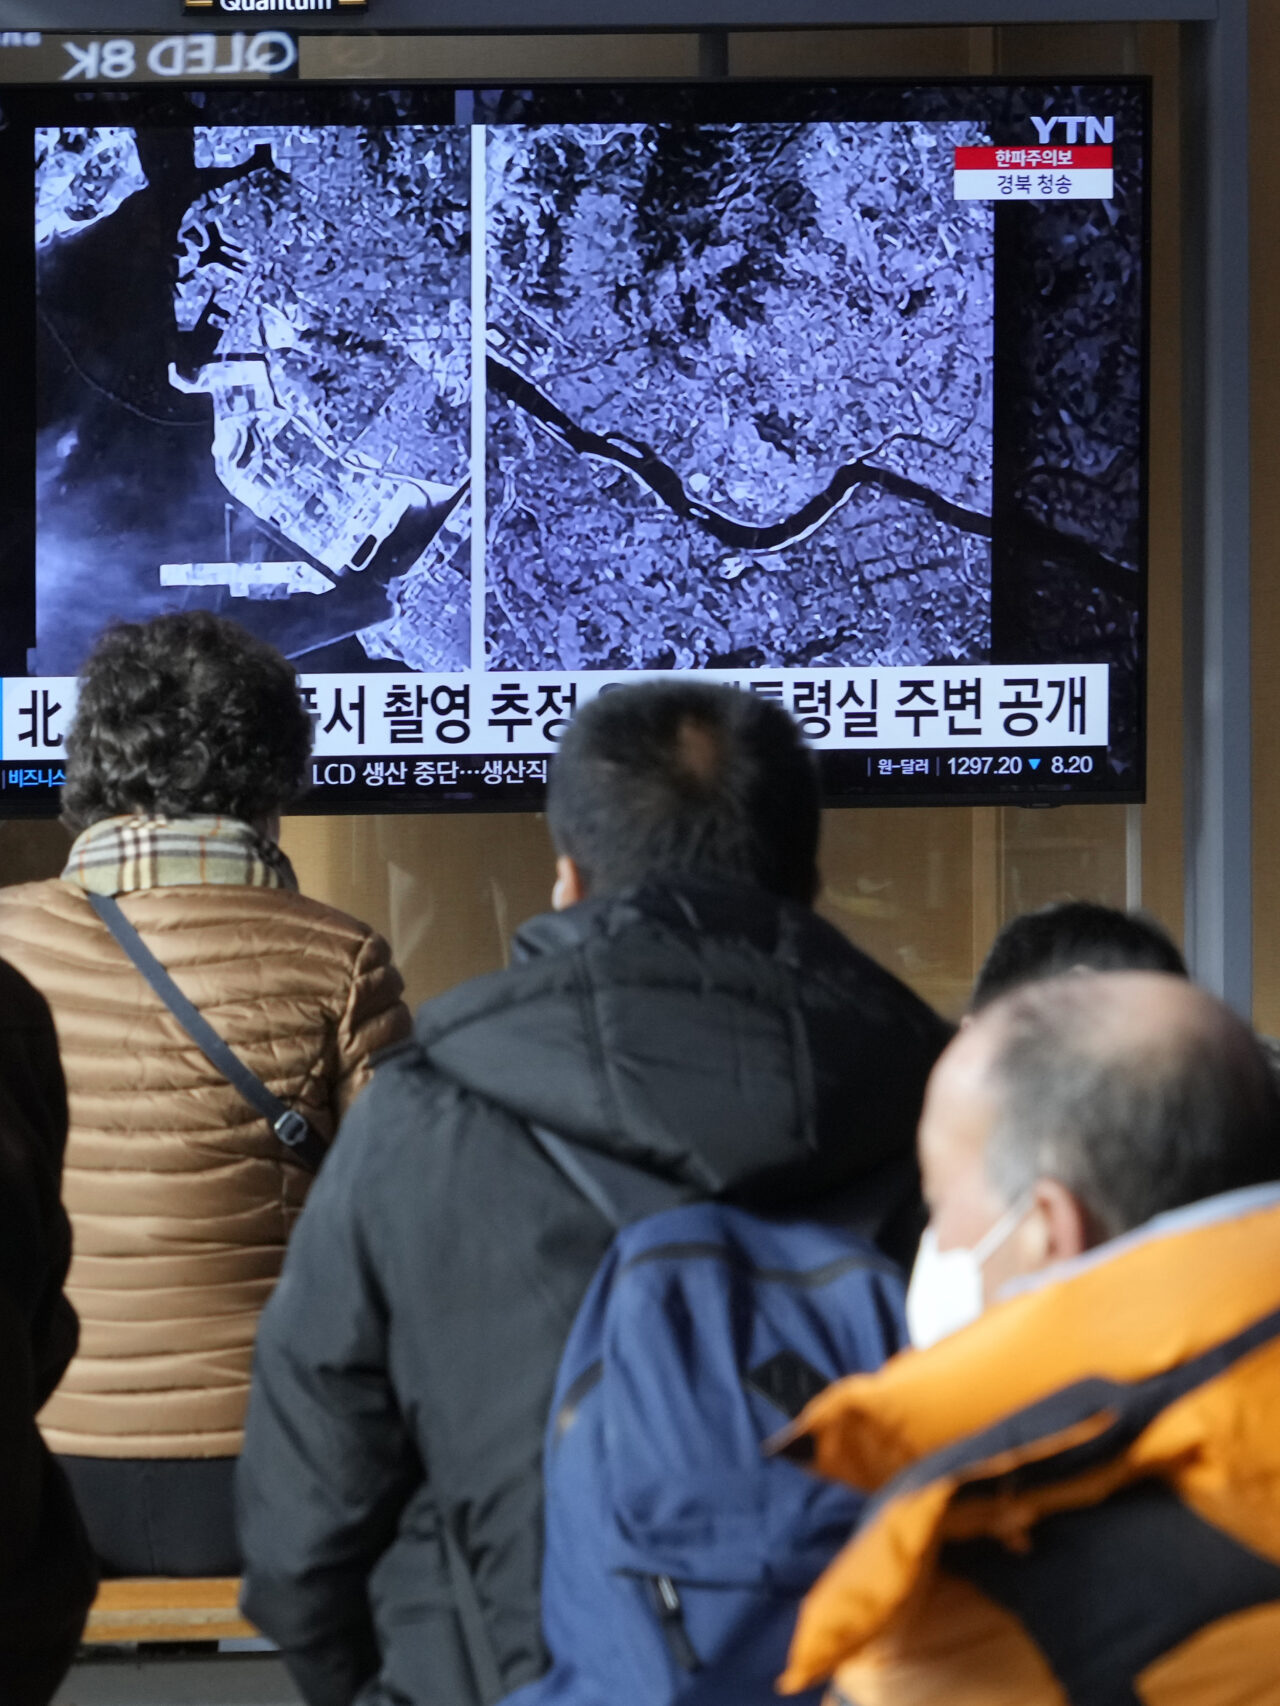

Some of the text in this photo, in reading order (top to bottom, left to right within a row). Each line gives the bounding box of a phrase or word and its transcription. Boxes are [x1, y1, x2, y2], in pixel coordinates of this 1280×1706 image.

[1030, 116, 1114, 144] YTN
[995, 149, 1074, 168] 한파주의보
[997, 173, 1072, 195] 경북 청송
[18, 690, 64, 748] 北
[383, 683, 471, 744] 촬영
[487, 682, 577, 743] 추정
[895, 677, 982, 737] 주변
[998, 676, 1087, 737] 공개
[312, 763, 356, 785] LCD
[362, 761, 407, 786] 생산
[877, 756, 1094, 776] 원-달러 1297.20 8.20
